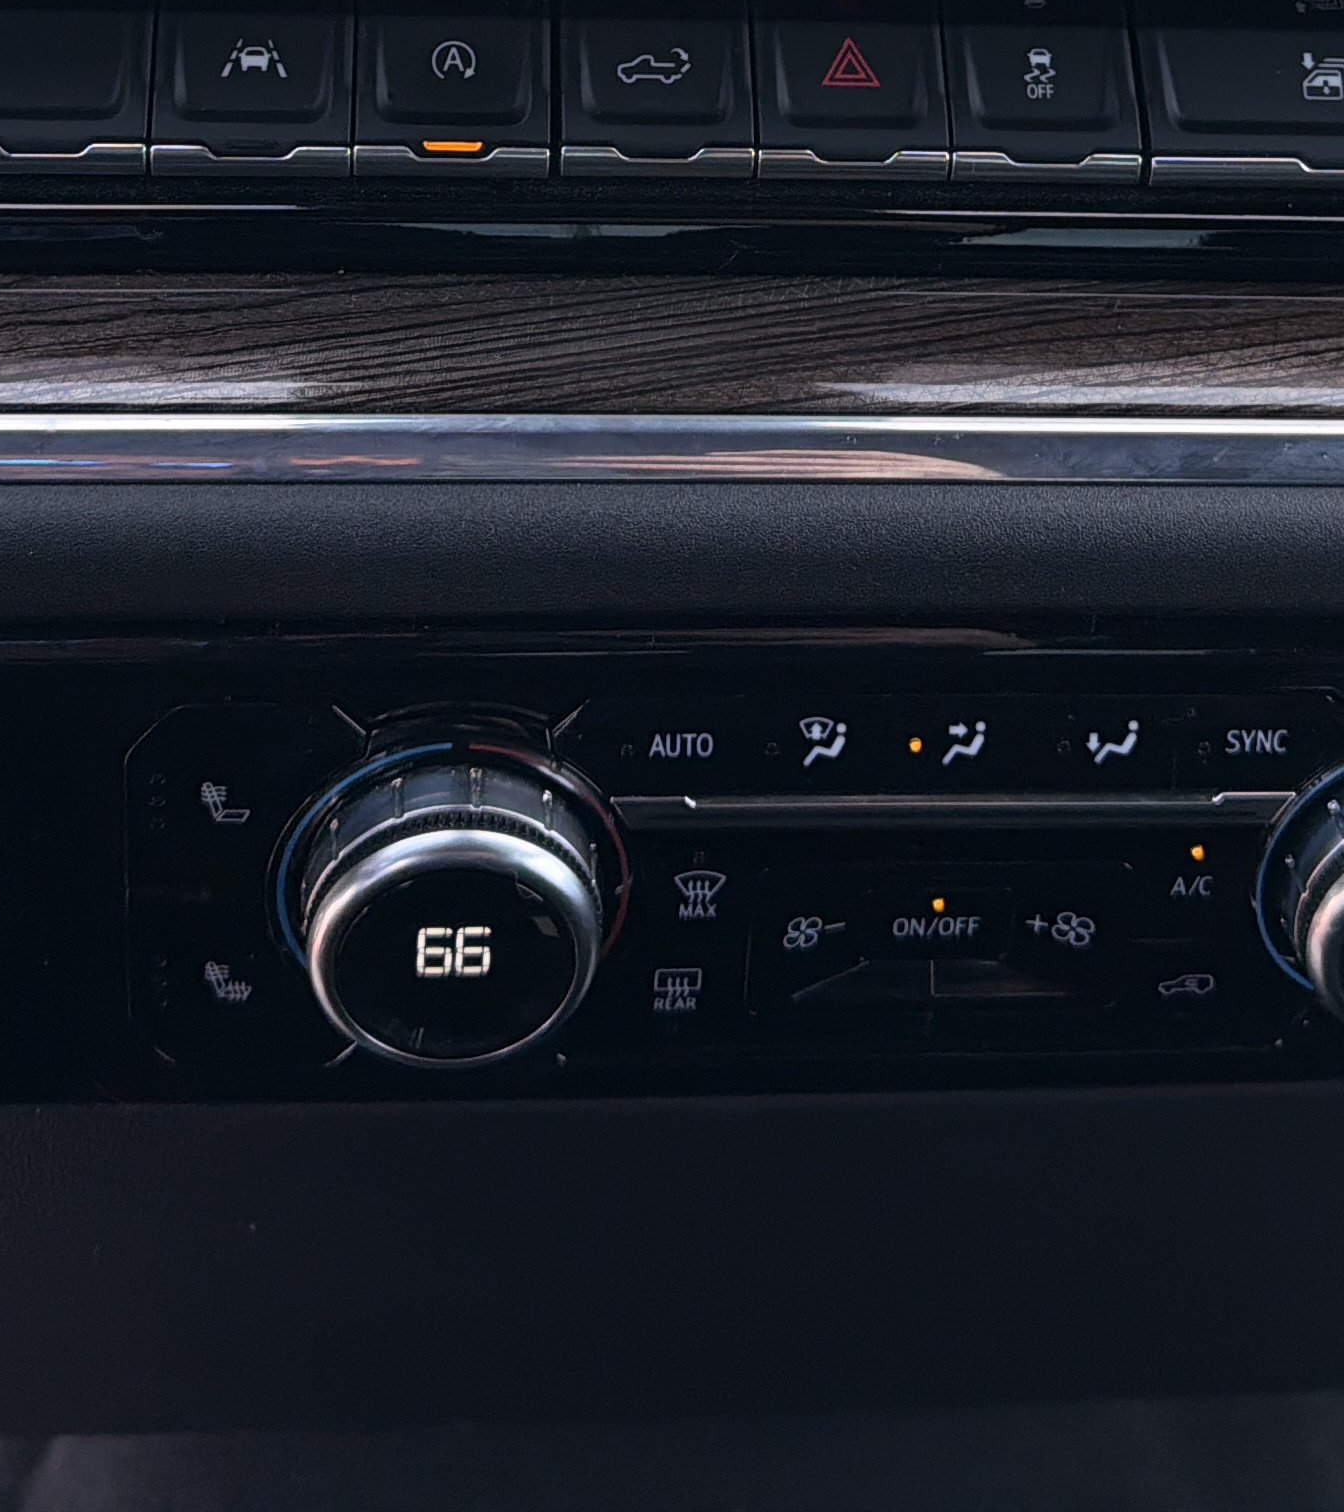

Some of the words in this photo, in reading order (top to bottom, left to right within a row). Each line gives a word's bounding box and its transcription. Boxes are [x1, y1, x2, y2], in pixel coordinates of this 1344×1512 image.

[1026, 83, 1055, 100] OFF
[648, 731, 714, 760] AUTO
[1224, 728, 1289, 756] SYNC
[1169, 875, 1214, 897] A/C
[678, 903, 718, 919] MAX
[892, 915, 981, 937] ON/OFF
[416, 926, 492, 977] 66
[653, 997, 697, 1010] REAR
